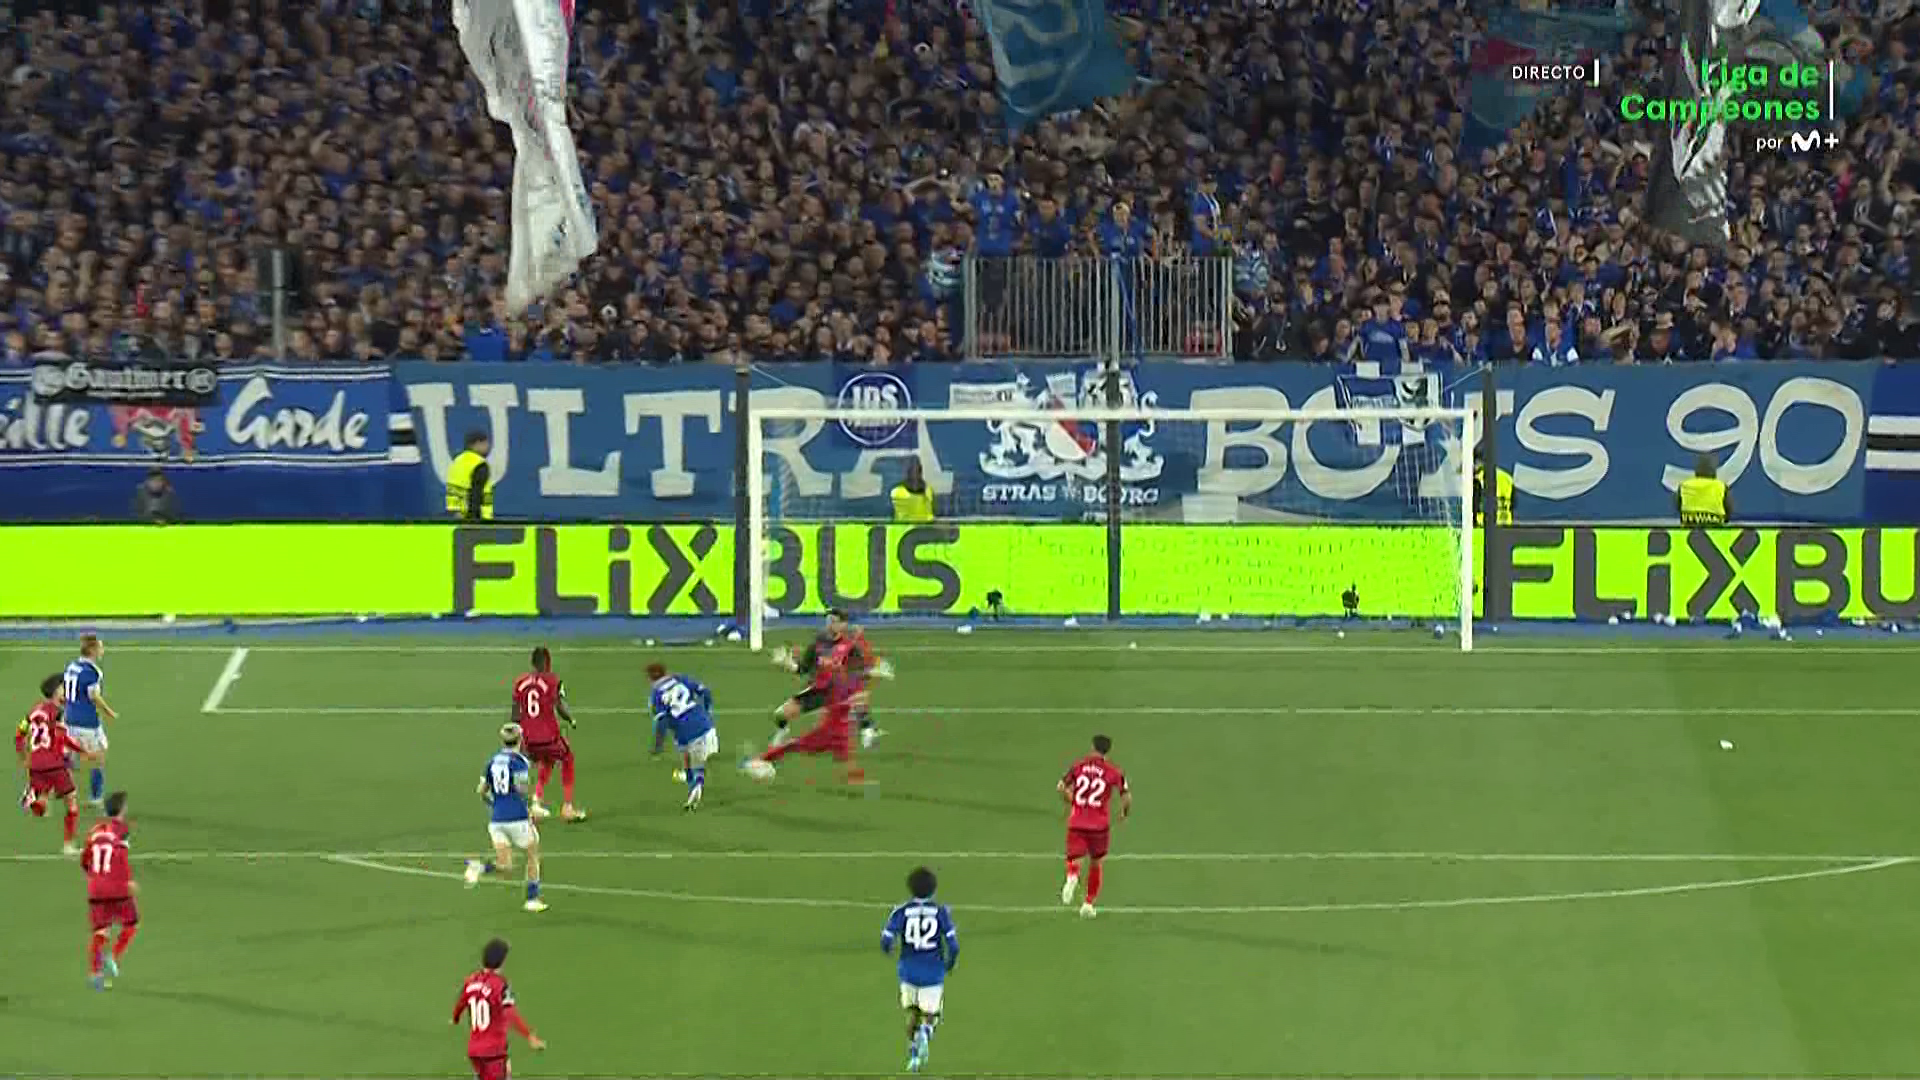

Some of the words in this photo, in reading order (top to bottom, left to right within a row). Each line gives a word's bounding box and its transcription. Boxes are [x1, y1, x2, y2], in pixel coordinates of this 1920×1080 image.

[225, 376, 370, 451] Garde
[406, 382, 954, 498] ULTRA
[1661, 376, 1865, 495] 90
[982, 484, 1057, 501] STRAS
[528, 690, 540, 717] 6
[1075, 774, 1106, 807] 22
[92, 844, 112, 873] 17
[905, 916, 938, 950] 42
[468, 996, 490, 1031] 10
